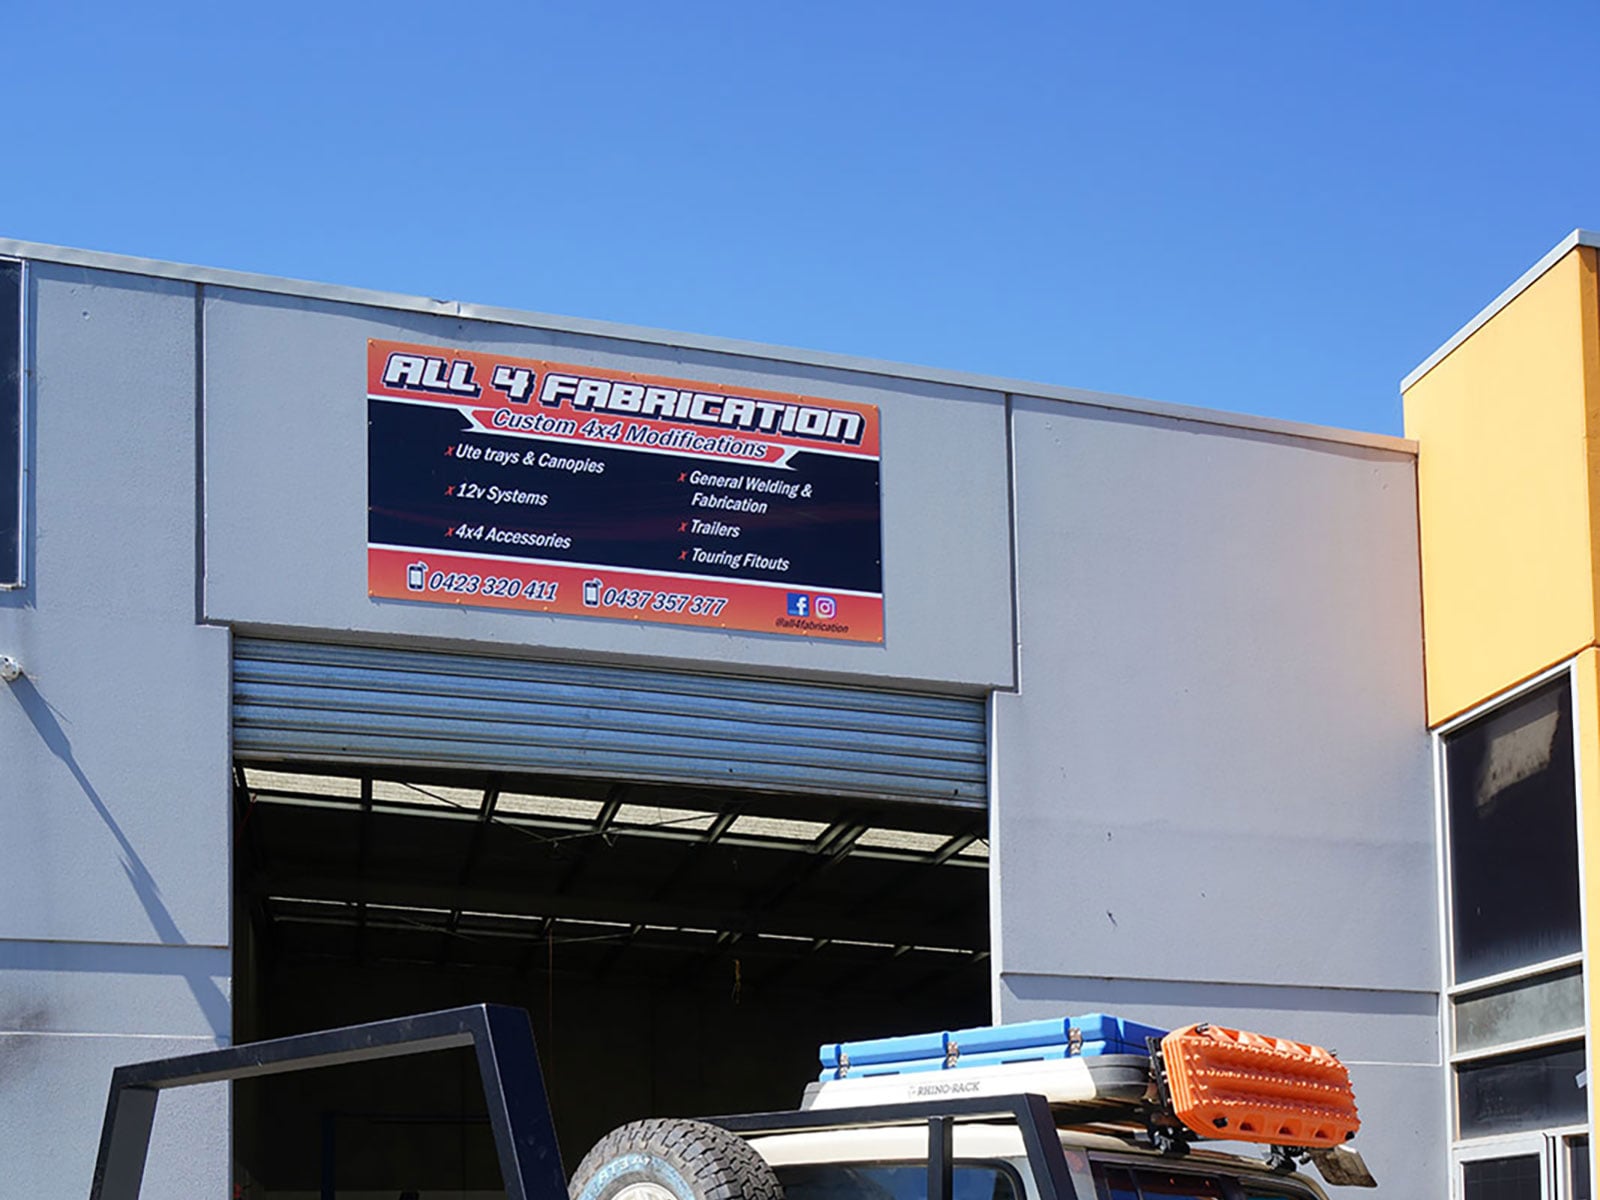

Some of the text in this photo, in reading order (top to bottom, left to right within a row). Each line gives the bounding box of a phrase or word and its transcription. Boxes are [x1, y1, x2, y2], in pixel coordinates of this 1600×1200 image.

[383, 352, 866, 446] ALL 4 FABRICATION
[493, 409, 768, 458] Custom 4x4 Modifications
[456, 443, 605, 474] Ute trays & Canopies
[456, 483, 549, 506] 12v Systems
[689, 469, 813, 498] General Welding &
[691, 492, 768, 515] Fabrication
[455, 523, 571, 549] 4x4 Accessories
[691, 519, 741, 538] Trailers
[691, 548, 790, 572] Touring Fitouts
[428, 572, 558, 601] 0423 320 411
[603, 588, 728, 617] 0437 357 377
